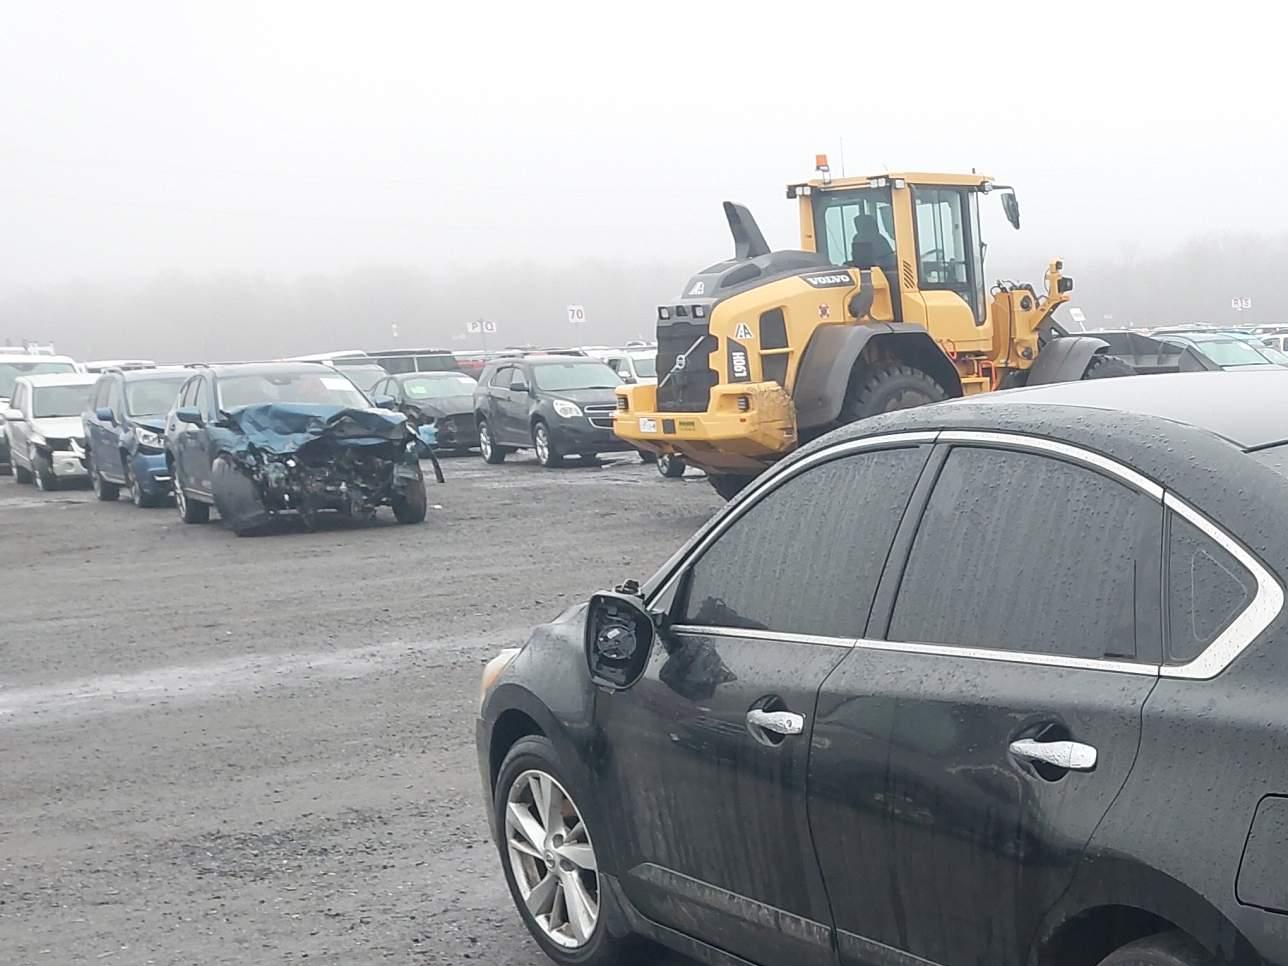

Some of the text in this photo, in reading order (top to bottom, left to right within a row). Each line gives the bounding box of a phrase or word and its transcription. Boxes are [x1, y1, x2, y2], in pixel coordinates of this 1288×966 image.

[806, 274, 850, 285] VOLVO
[568, 308, 584, 320] 70
[731, 351, 748, 378] L90H
